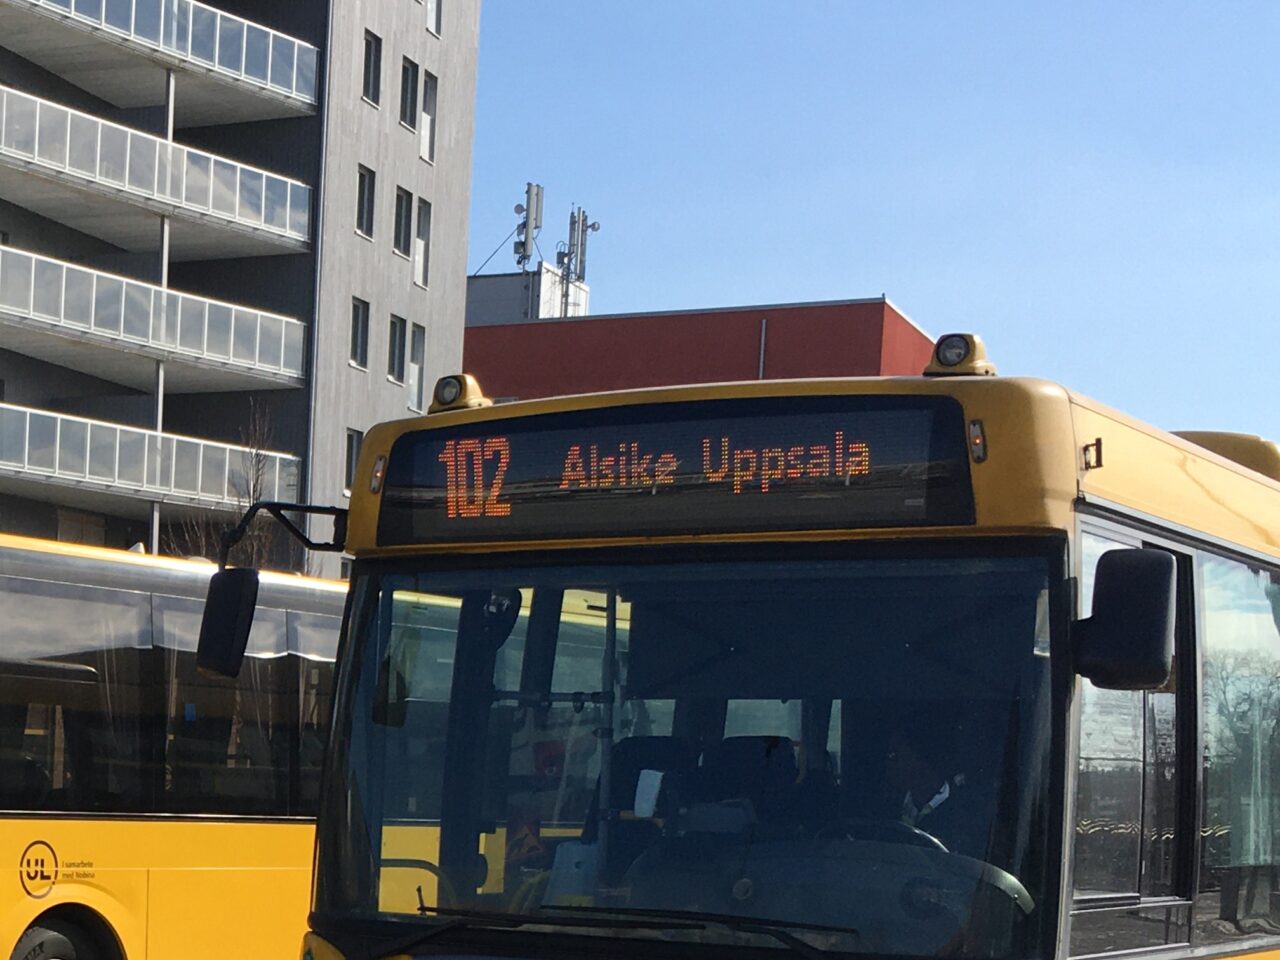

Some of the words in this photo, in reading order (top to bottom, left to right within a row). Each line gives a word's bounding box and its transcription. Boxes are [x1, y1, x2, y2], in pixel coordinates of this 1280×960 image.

[439, 436, 512, 518] 102
[560, 442, 678, 489] Alsike
[702, 431, 870, 494] Uppsala
[27, 859, 51, 880] UL
